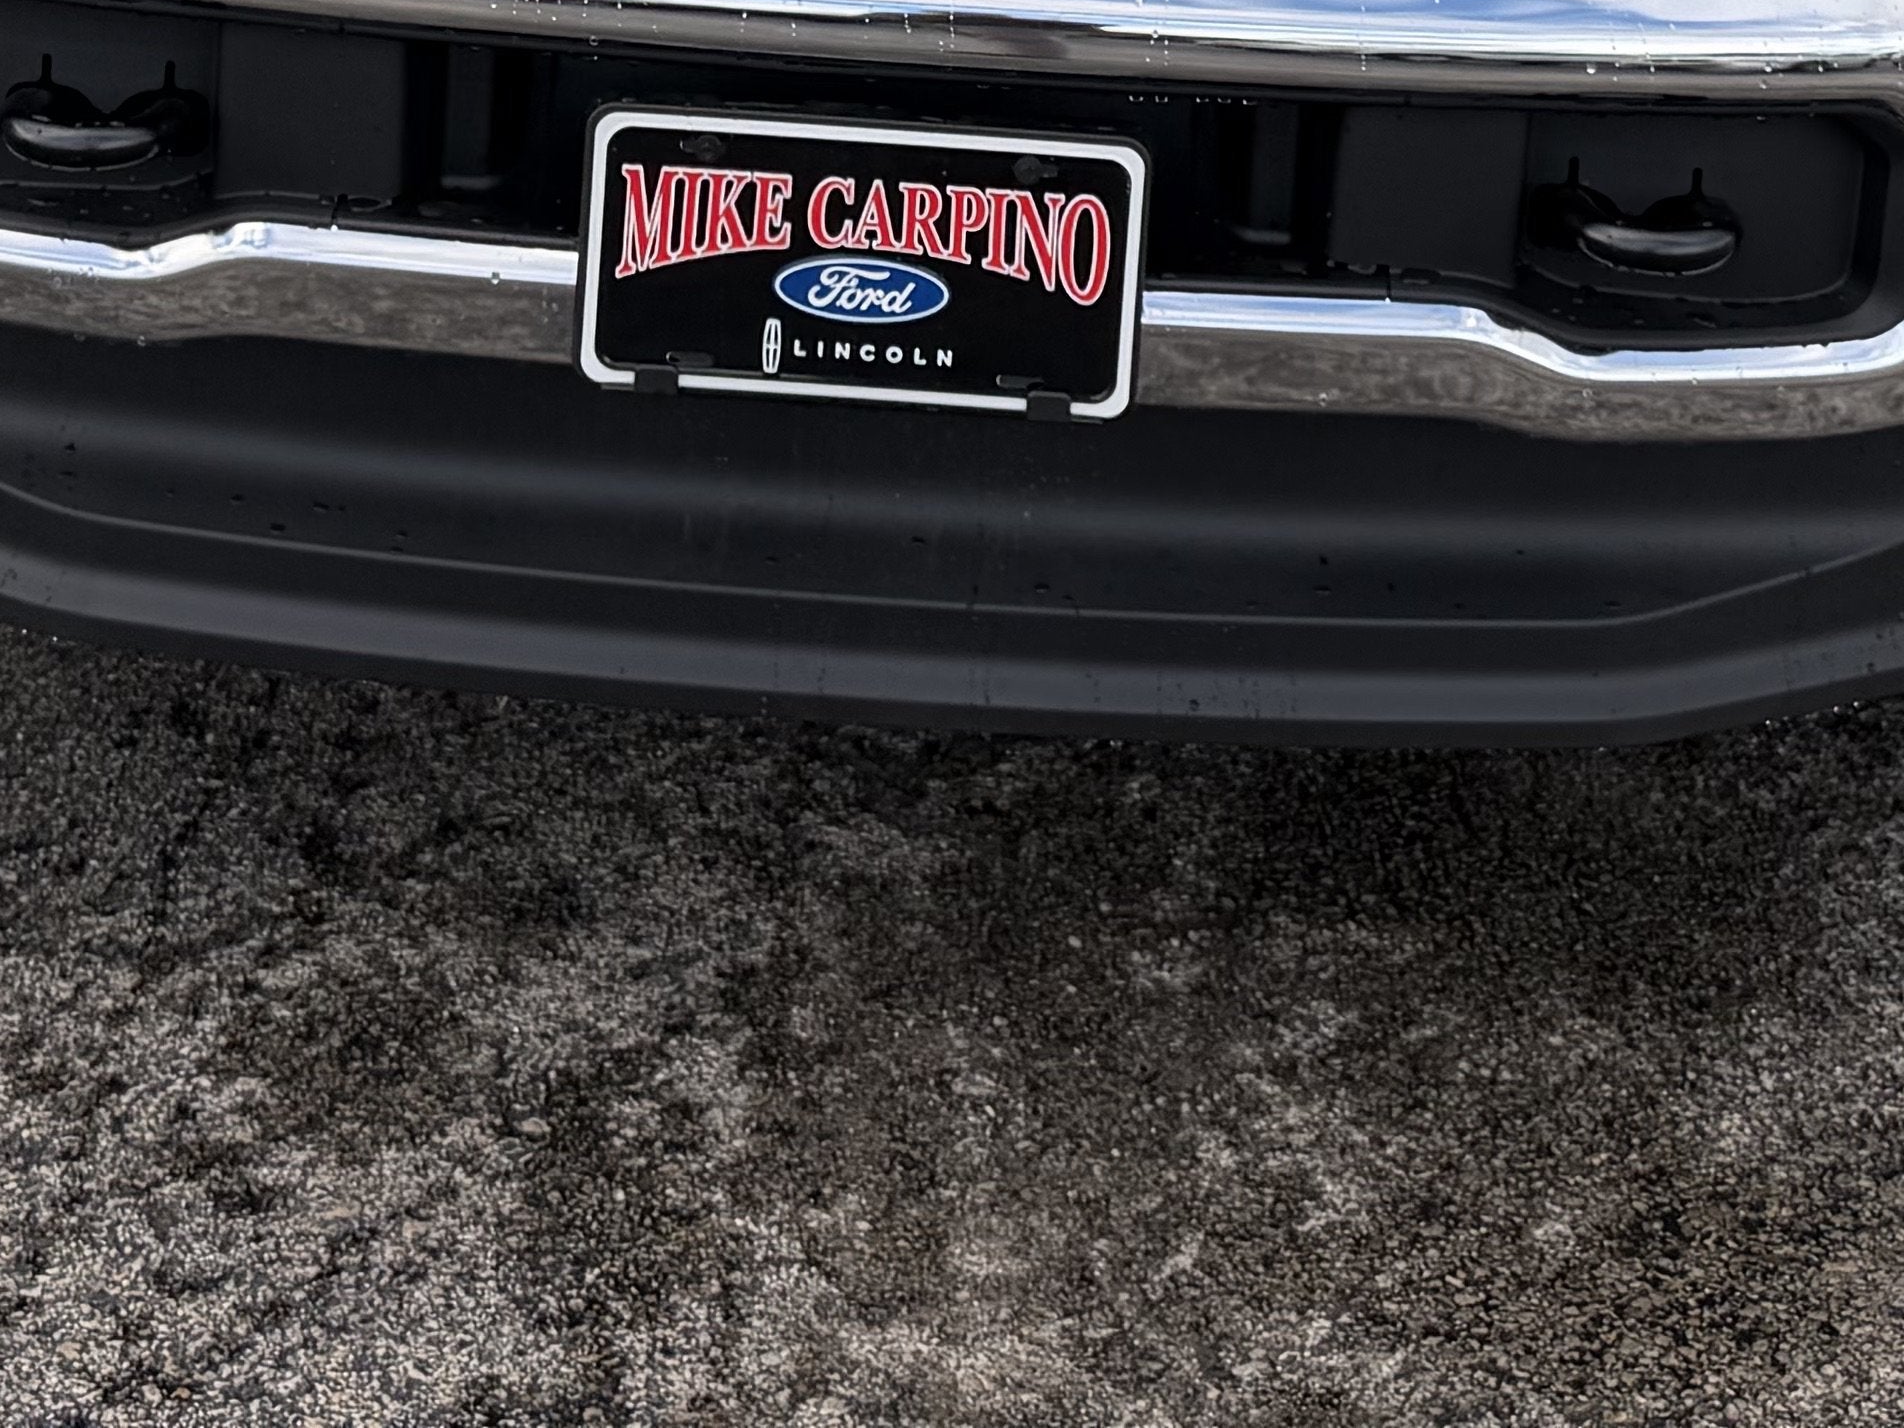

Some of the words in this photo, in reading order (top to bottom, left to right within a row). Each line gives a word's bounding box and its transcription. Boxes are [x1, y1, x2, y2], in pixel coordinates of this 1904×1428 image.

[614, 163, 793, 279] MIKE
[806, 176, 1112, 307] CARPINO
[807, 264, 917, 314] Ford
[792, 337, 954, 369] LINCOLN
